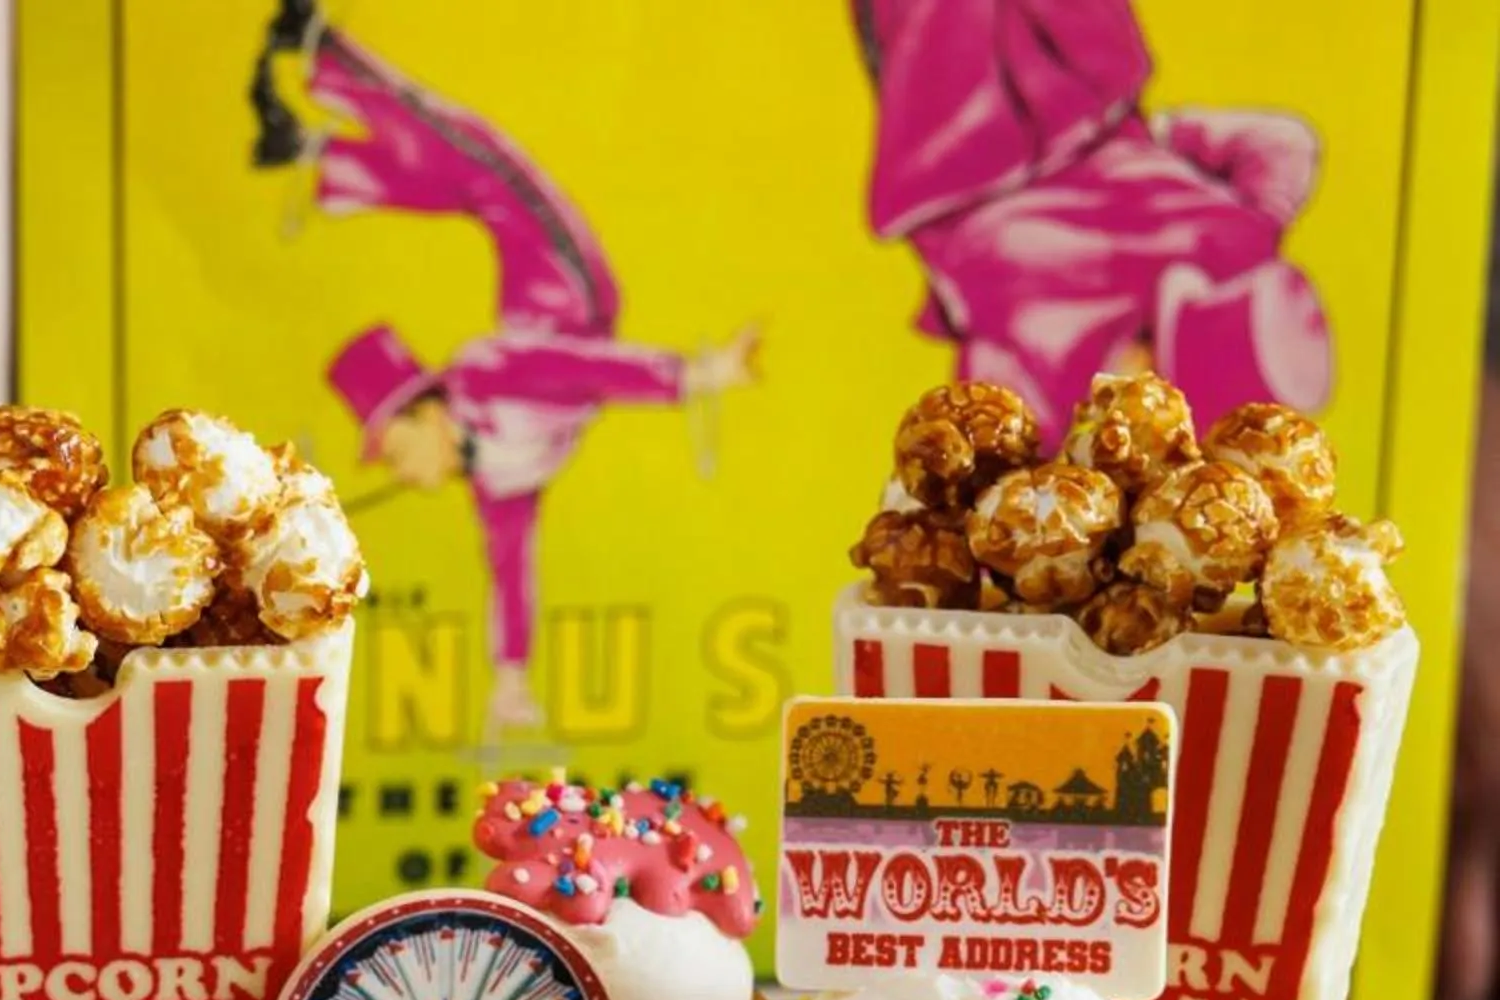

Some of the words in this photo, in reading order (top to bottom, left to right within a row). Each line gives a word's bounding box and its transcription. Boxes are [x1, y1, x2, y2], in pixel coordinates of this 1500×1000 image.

[935, 819, 1011, 849] THE
[785, 848, 1161, 930] WORLD'S
[826, 932, 925, 967] BEST
[937, 934, 1113, 975] ADDRESS
